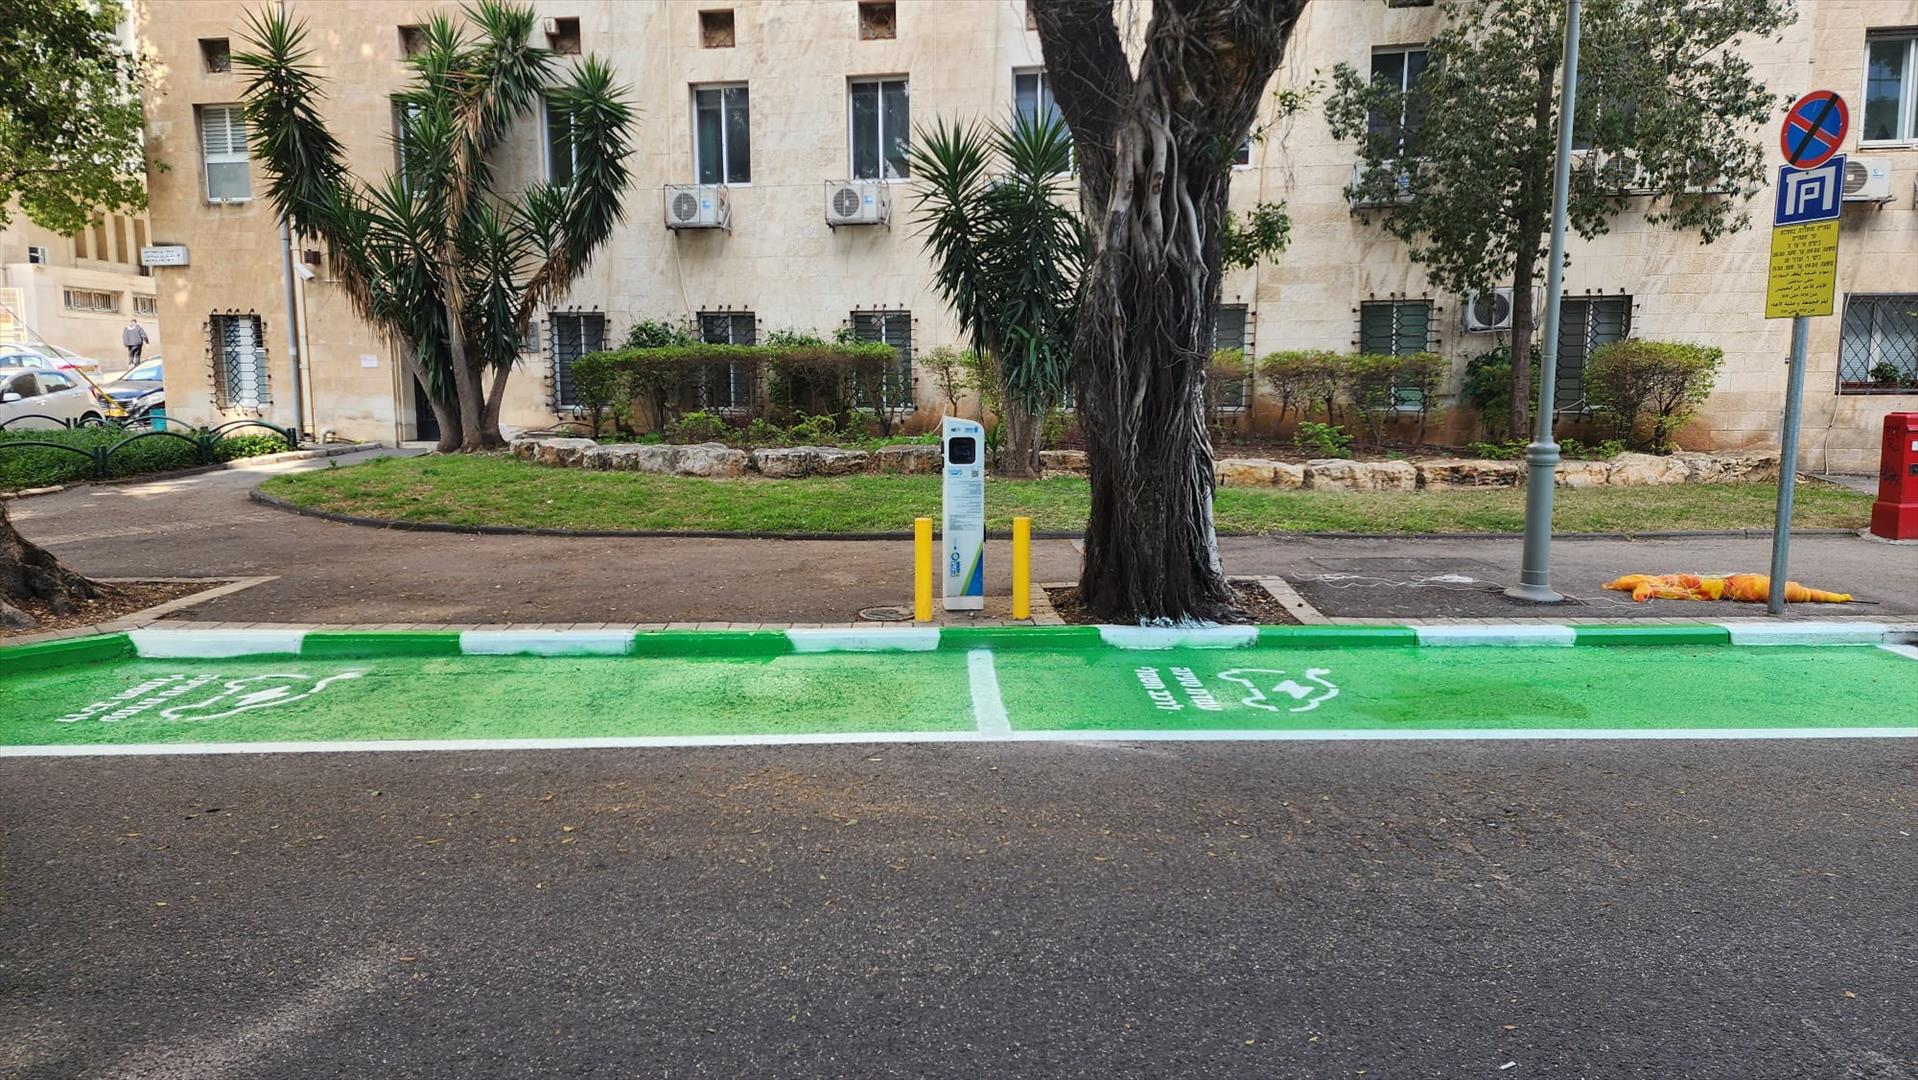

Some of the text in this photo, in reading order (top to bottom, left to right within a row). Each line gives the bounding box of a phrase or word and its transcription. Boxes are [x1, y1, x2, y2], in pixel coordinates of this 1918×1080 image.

[1798, 182, 1821, 214] P
[54, 674, 184, 723] לרכב חשמלי
[99, 698, 168, 722] עמדת
[1134, 666, 1184, 711] לרכב חשמלי
[1169, 667, 1223, 711] עמדת טעינה
